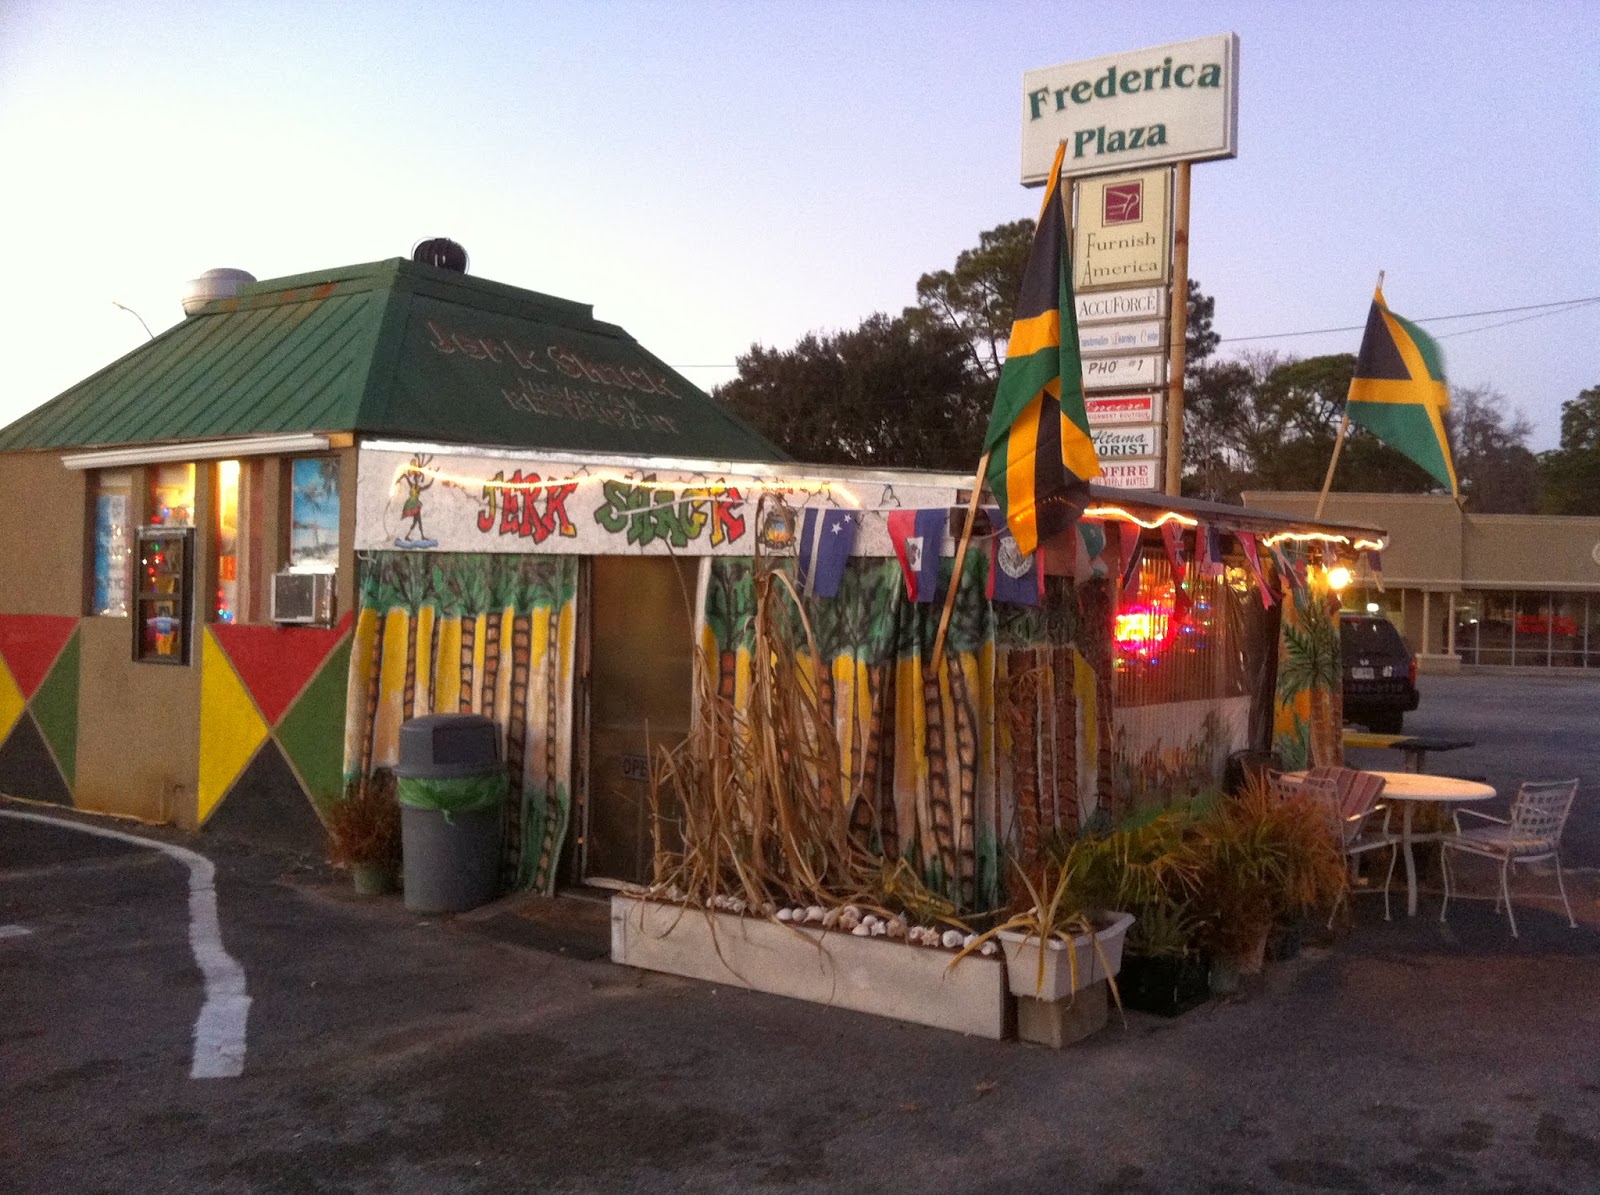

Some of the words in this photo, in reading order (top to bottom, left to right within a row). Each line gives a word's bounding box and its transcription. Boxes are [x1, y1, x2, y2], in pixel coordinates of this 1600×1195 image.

[1028, 57, 1222, 122] Frederica
[1073, 122, 1168, 159] Plaza
[1086, 232, 1157, 259] Furnish
[1081, 259, 1159, 287] America
[1098, 445, 1149, 456] ORIST
[477, 469, 579, 545] JERK
[594, 473, 746, 548] SHACK
[623, 757, 648, 777] OPE
